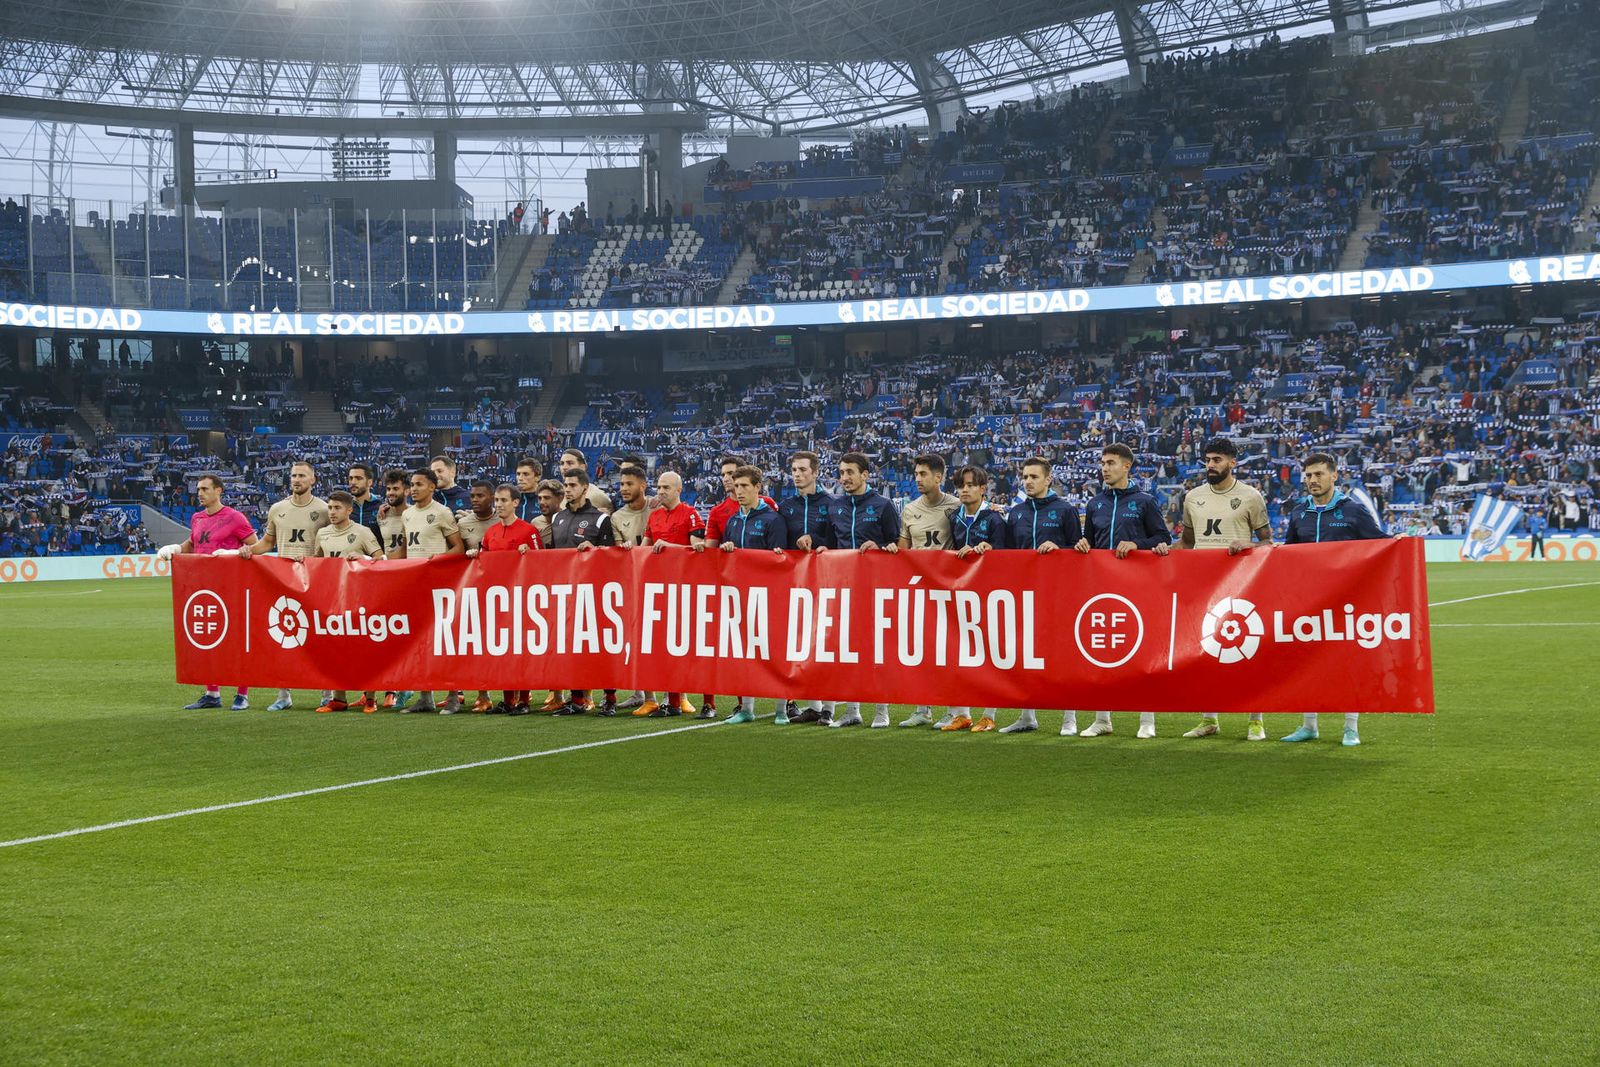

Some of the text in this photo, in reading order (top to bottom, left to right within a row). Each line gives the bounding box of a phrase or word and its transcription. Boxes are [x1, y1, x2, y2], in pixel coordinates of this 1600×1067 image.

[1183, 267, 1434, 305] REAL SOCIEDAD
[863, 289, 1090, 322] REAL SOCIEDAD
[233, 313, 465, 335] REAL SOCIEDAD
[553, 305, 775, 332] REAL SOCIEDAD
[1526, 366, 1556, 374] KEL
[578, 432, 633, 448] INSALU
[199, 531, 211, 544] JK
[289, 528, 306, 543] JK
[408, 531, 420, 546] JK
[1203, 519, 1222, 536] JK
[924, 531, 941, 547] JK
[102, 556, 170, 578] CAZO
[313, 606, 410, 642] LaLiga
[432, 575, 1045, 670] RACISTAS, FUERA DEL FÚTBOL
[1274, 603, 1411, 649] LaLiga
